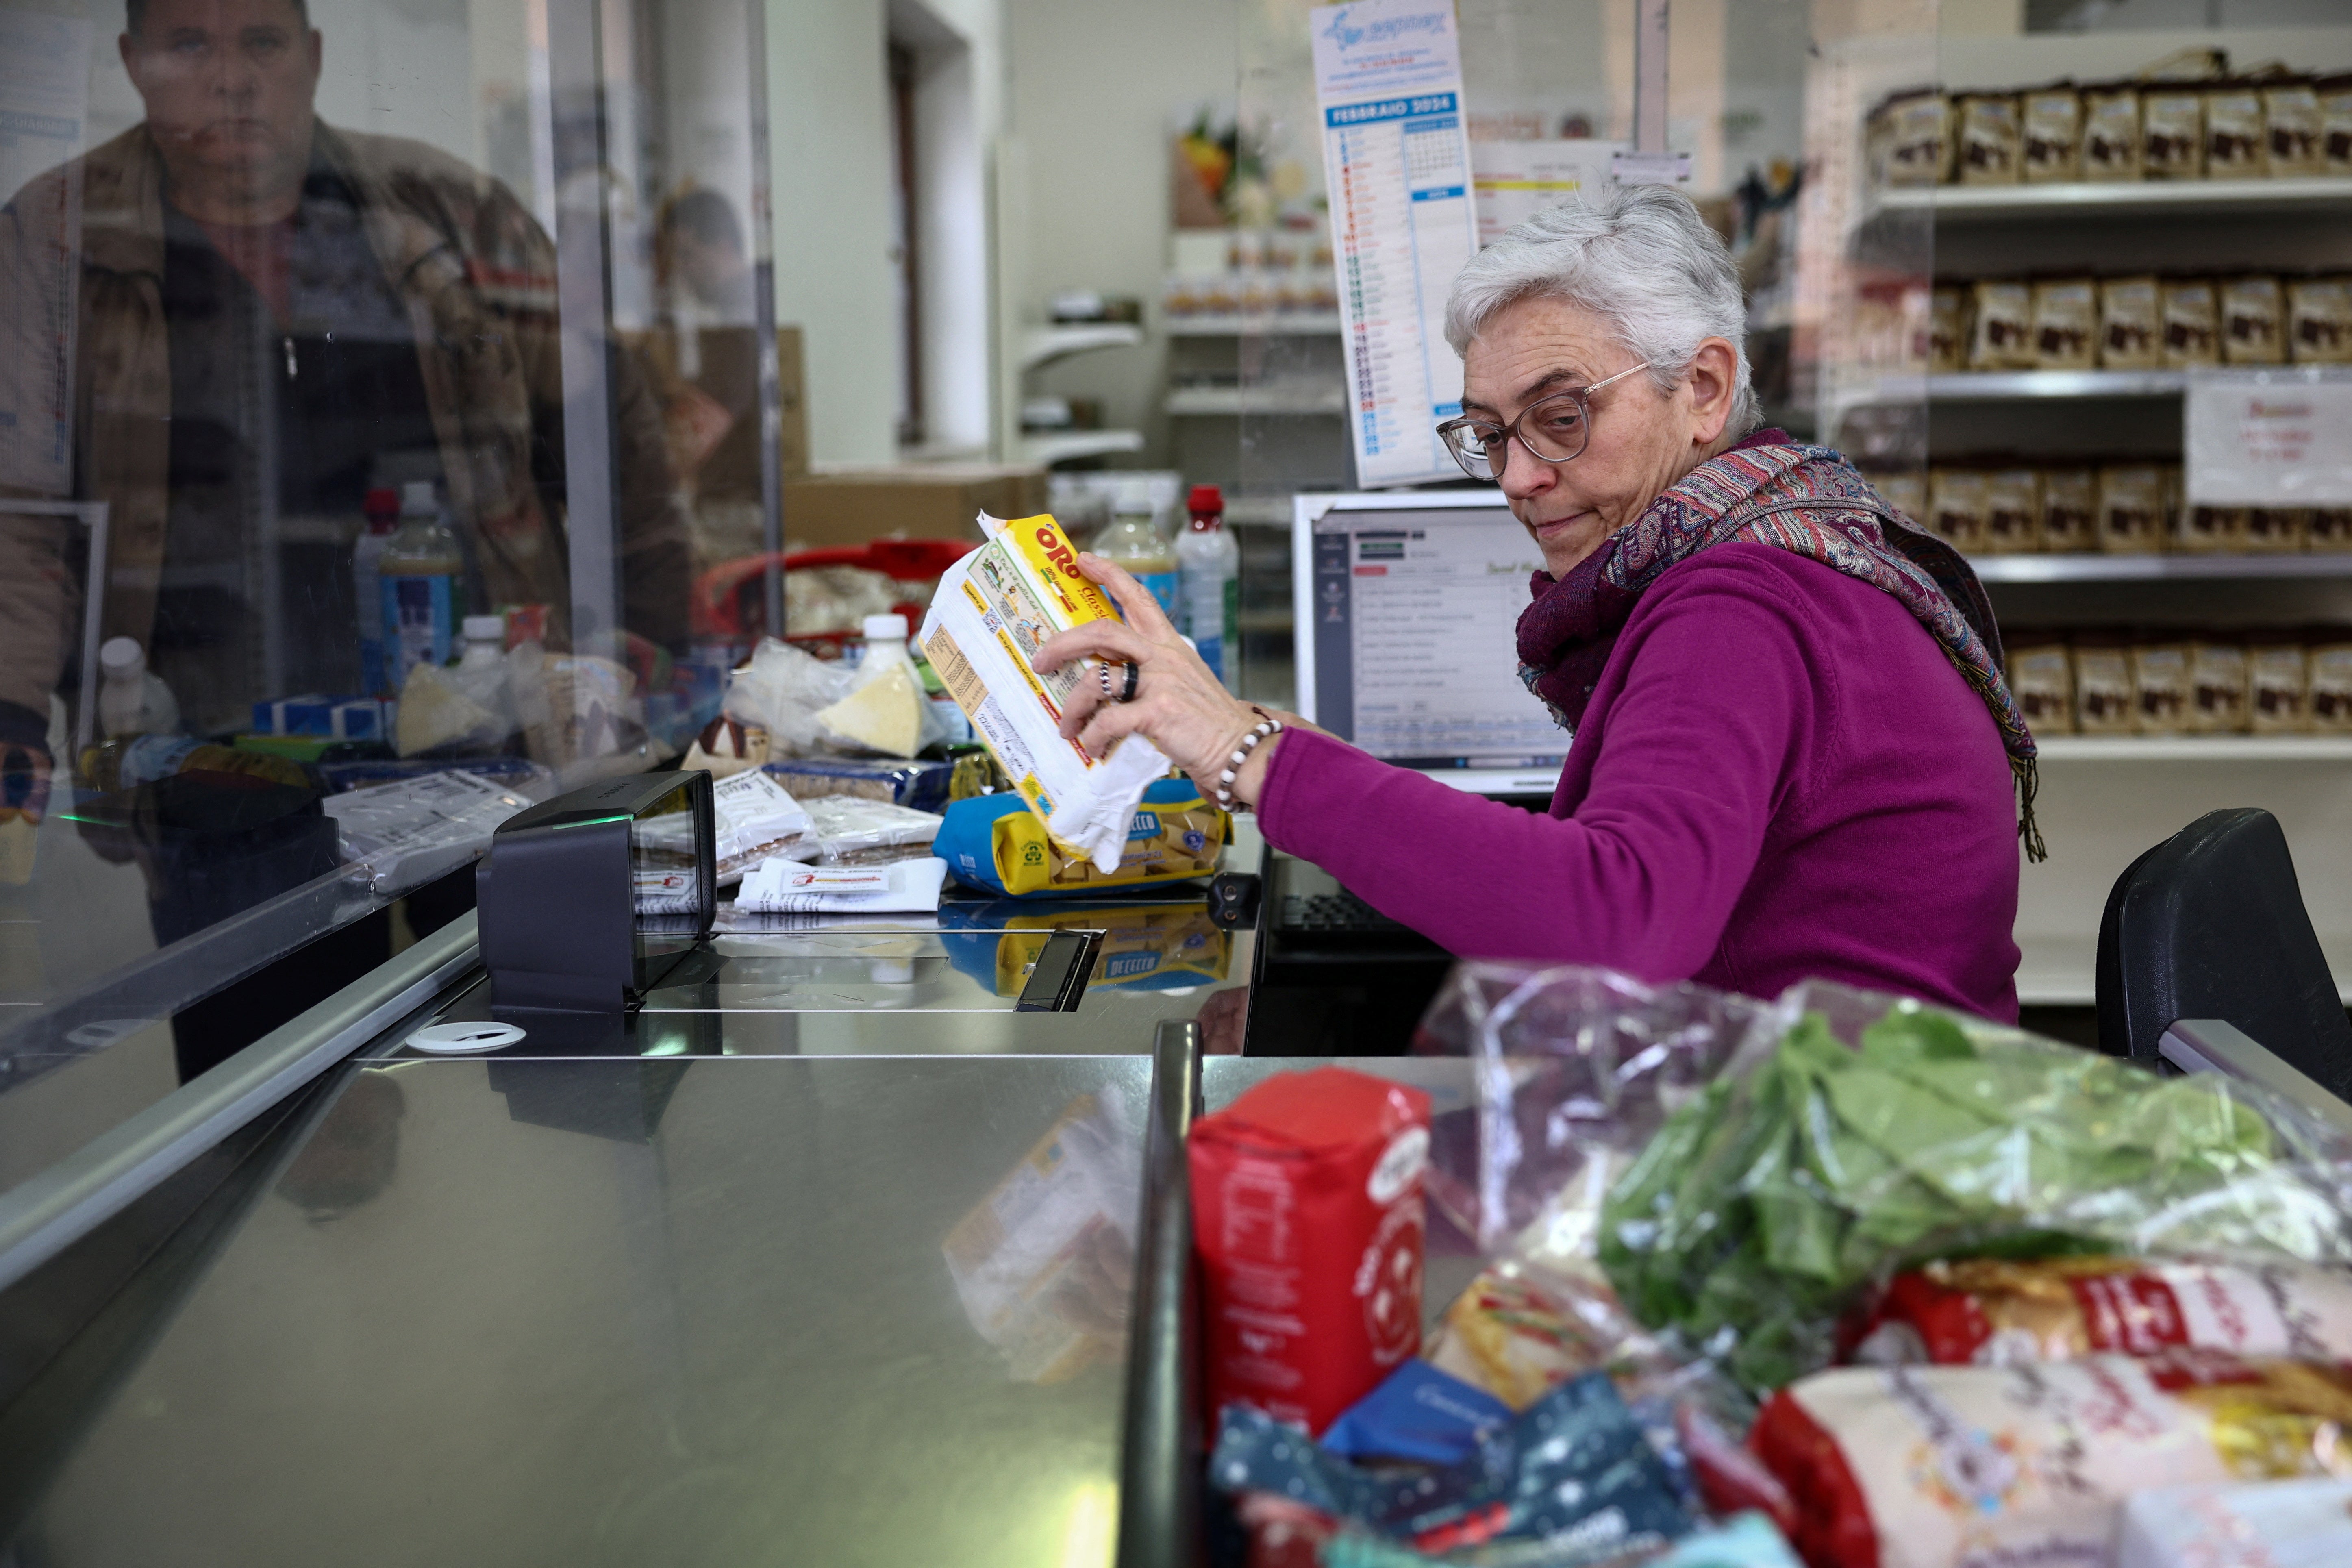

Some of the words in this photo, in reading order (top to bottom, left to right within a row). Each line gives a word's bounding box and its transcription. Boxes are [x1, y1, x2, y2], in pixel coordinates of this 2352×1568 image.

[1333, 100, 1408, 123] FEBBRAIO
[1413, 96, 1450, 113] 2024
[1036, 528, 1080, 579] ORO
[1045, 567, 1058, 581] 100%
[1064, 593, 1079, 611] ITALIANO
[1082, 587, 1110, 618] Classi
[1130, 814, 1155, 831] ECCO
